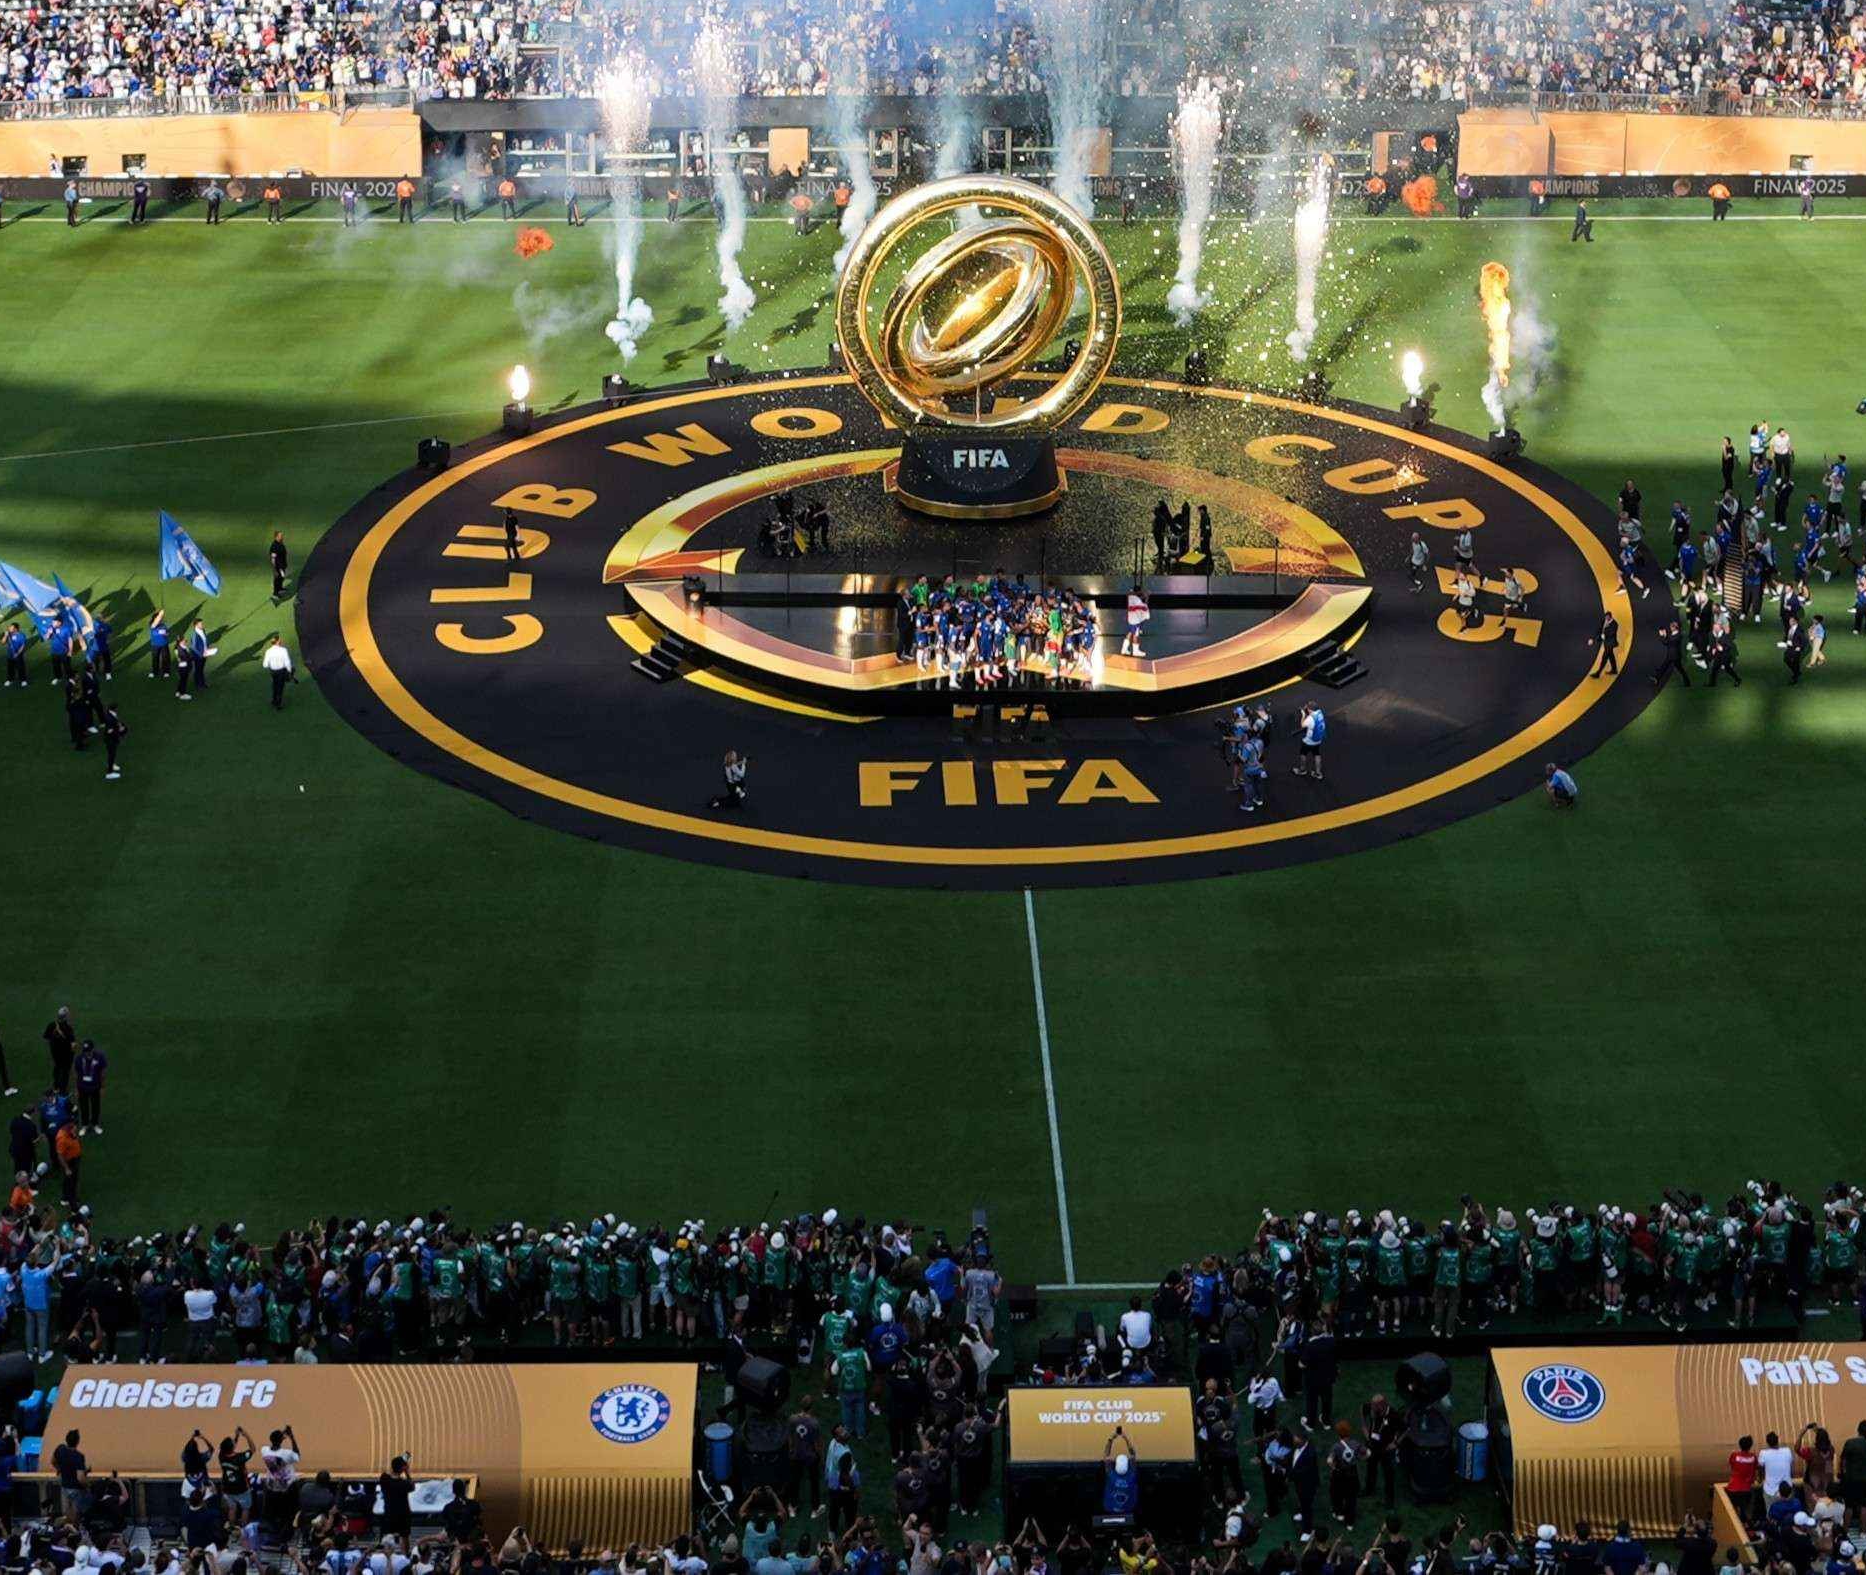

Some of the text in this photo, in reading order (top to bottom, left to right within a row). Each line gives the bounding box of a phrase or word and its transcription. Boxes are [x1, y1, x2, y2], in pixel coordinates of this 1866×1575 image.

[366, 181, 397, 197] 202
[952, 449, 1010, 469] FIFA
[434, 481, 597, 654] CLUB
[606, 400, 1171, 468] WOD
[1244, 432, 1486, 532] CUP
[858, 759, 1161, 806] FIFA
[1533, 1368, 1585, 1381] PARIS
[1740, 1354, 1840, 1386] Paris
[69, 1378, 277, 1408] Chelsea FC
[1063, 1400, 1133, 1411] FIFA CLUB
[1038, 1412, 1091, 1424] WORLD
[1093, 1412, 1122, 1424] CUP
